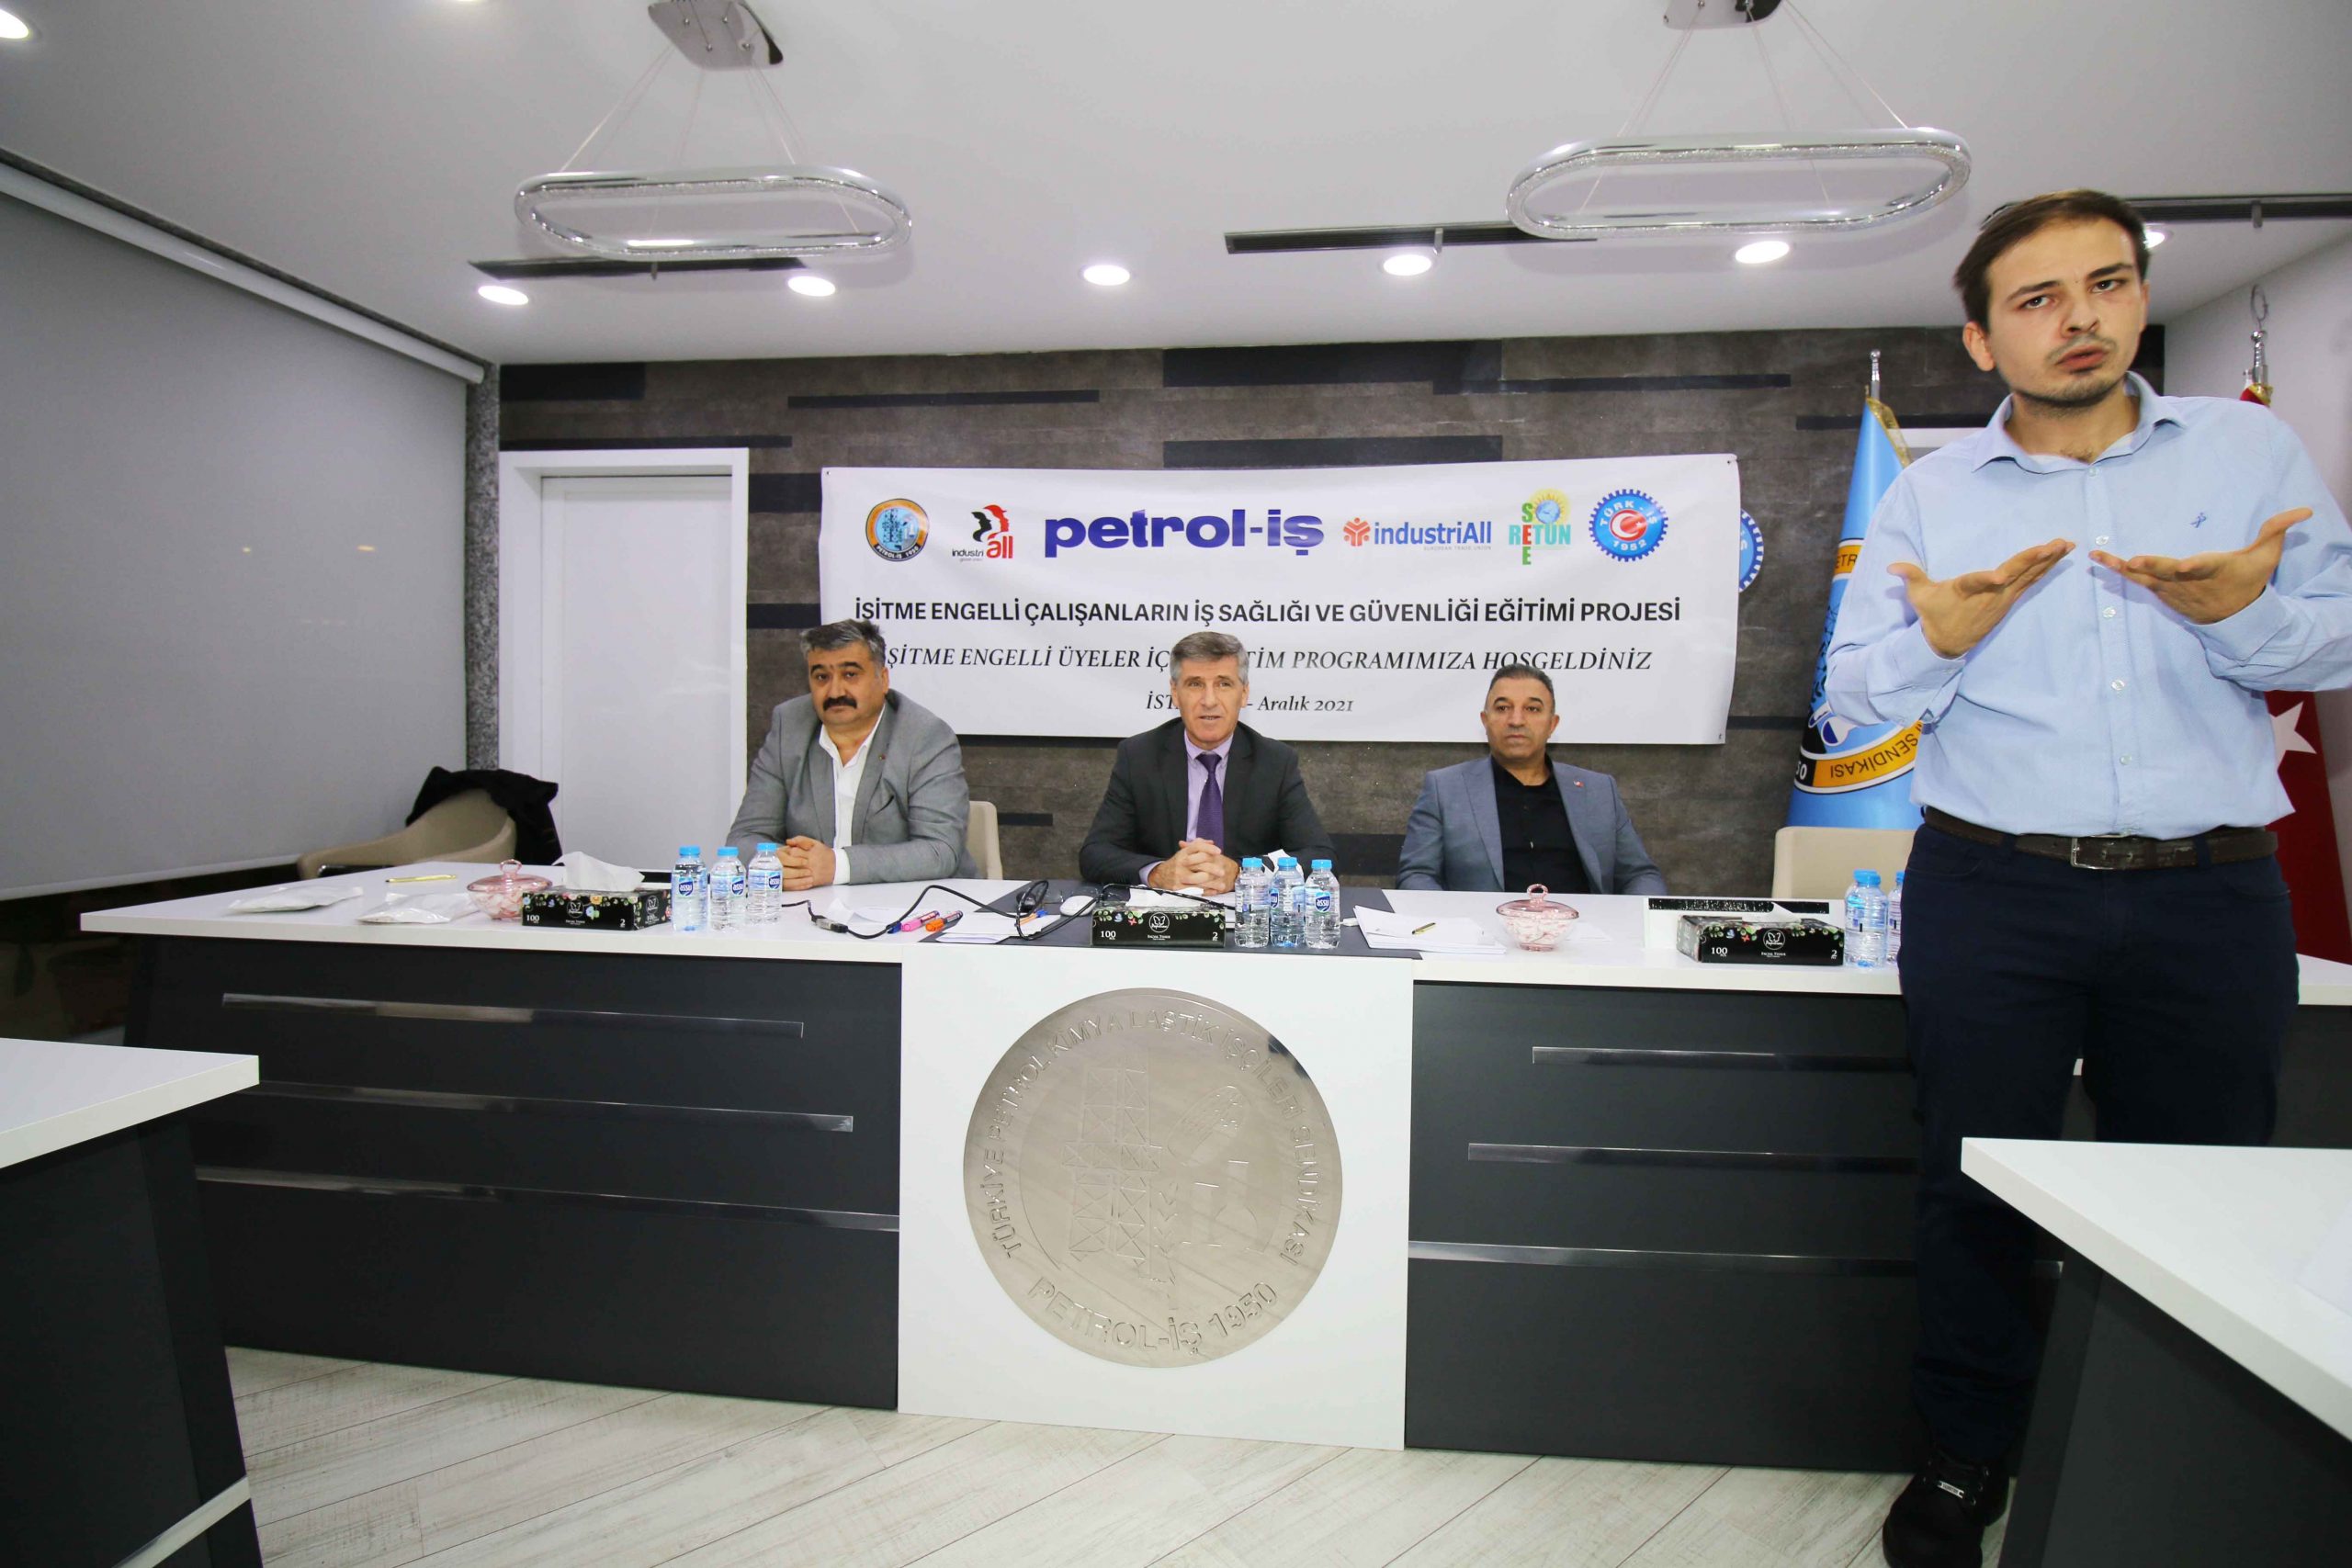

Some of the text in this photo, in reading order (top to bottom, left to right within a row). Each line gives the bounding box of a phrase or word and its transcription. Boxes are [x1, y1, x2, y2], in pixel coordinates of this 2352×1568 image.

[1045, 509, 1325, 558] petrol-iş
[1374, 521, 1492, 545] industriAll
[986, 536, 1014, 558] all
[932, 598, 1020, 621] ENGELLİ
[1025, 603, 1189, 626] ÇALIŞANLARIN
[1194, 600, 1215, 626] İŞ
[1219, 600, 1310, 622] SAĞLIĞI
[1316, 604, 1345, 622] VE
[1350, 598, 1479, 622] GÜVENLİĞİ
[1485, 598, 1576, 622] EĞİTİMİ
[1581, 597, 1680, 621] PROJESİ
[959, 646, 1053, 667] ENGELLİ
[1058, 646, 1141, 668] ÜYELER
[1292, 650, 1476, 670] PROGRAMIMIZA
[1257, 695, 1310, 712] Aralık
[1314, 699, 1354, 712] 2021
[1830, 732, 1918, 779] SENDİKASI
[526, 914, 540, 922] 100
[1101, 931, 1116, 939] 100
[1213, 931, 1218, 940] 2
[1711, 947, 1728, 955] 100
[1831, 950, 1838, 958] 2
[979, 1148, 1022, 1259] TÜRKİYE
[1208, 1281, 1278, 1338] 1950
